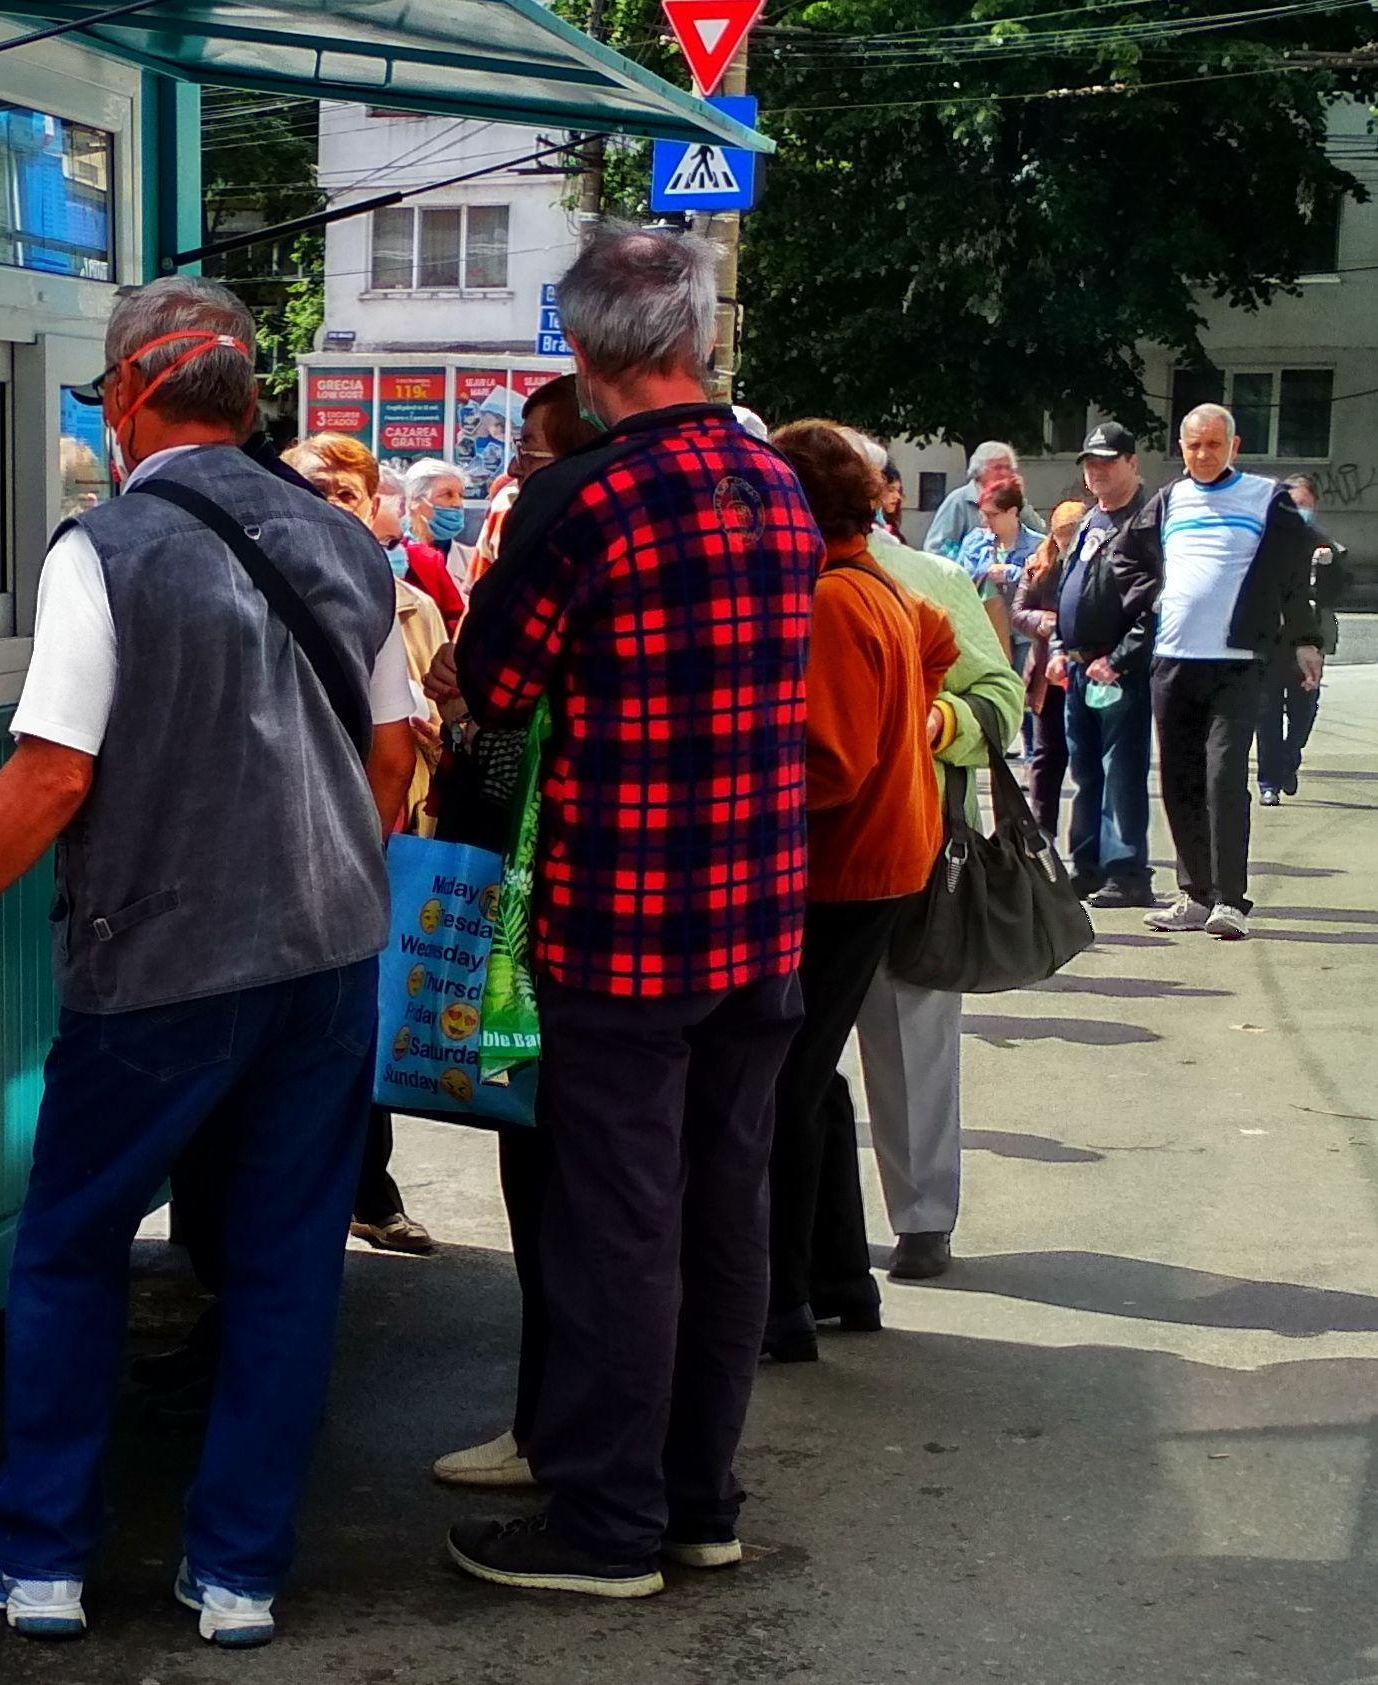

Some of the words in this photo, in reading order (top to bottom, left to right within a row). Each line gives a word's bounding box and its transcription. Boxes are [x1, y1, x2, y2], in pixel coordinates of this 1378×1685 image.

[316, 379, 364, 391] GRECIA
[316, 411, 326, 427] 3
[385, 426, 438, 437] CAZAREA
[391, 437, 432, 447] GRATIS
[478, 1030, 511, 1048] ble
[409, 1037, 479, 1066] Saturda
[383, 1063, 439, 1095] Sunday
